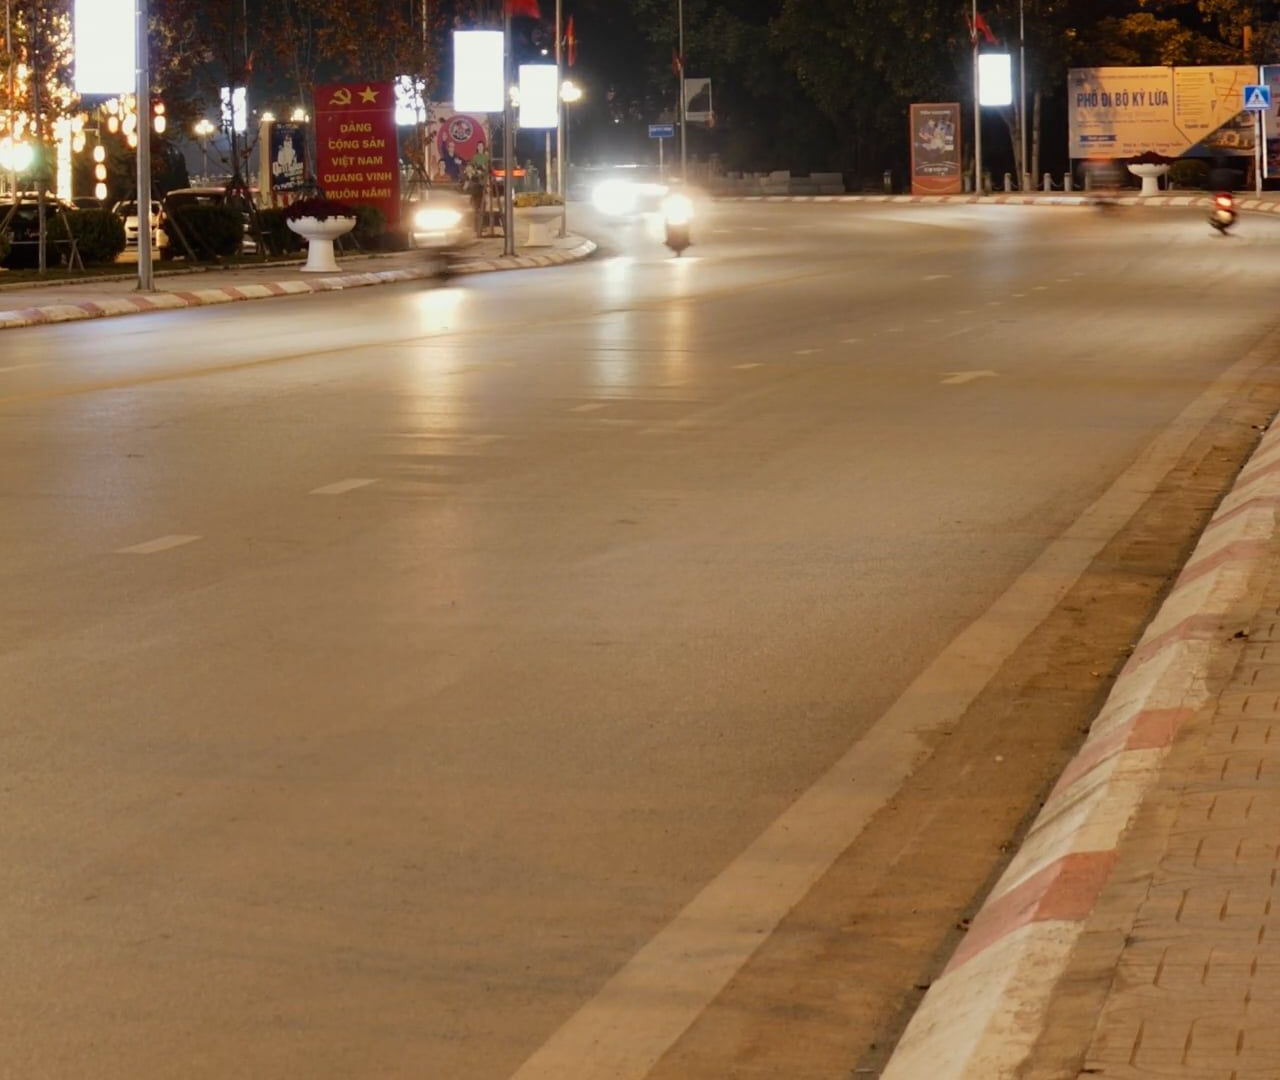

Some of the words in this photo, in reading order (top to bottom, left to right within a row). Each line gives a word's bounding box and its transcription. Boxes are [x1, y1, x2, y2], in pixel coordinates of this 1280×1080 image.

[1077, 89, 1099, 108] PHỐ
[1115, 89, 1130, 110] BỘ
[1132, 88, 1146, 107] KỲ
[1148, 88, 1169, 107] LỪA
[328, 138, 359, 151] CỘNG
[331, 154, 355, 168] VIỆT
[358, 156, 383, 165] NAM
[324, 173, 363, 182] QUANG
[366, 172, 392, 181] VINH
